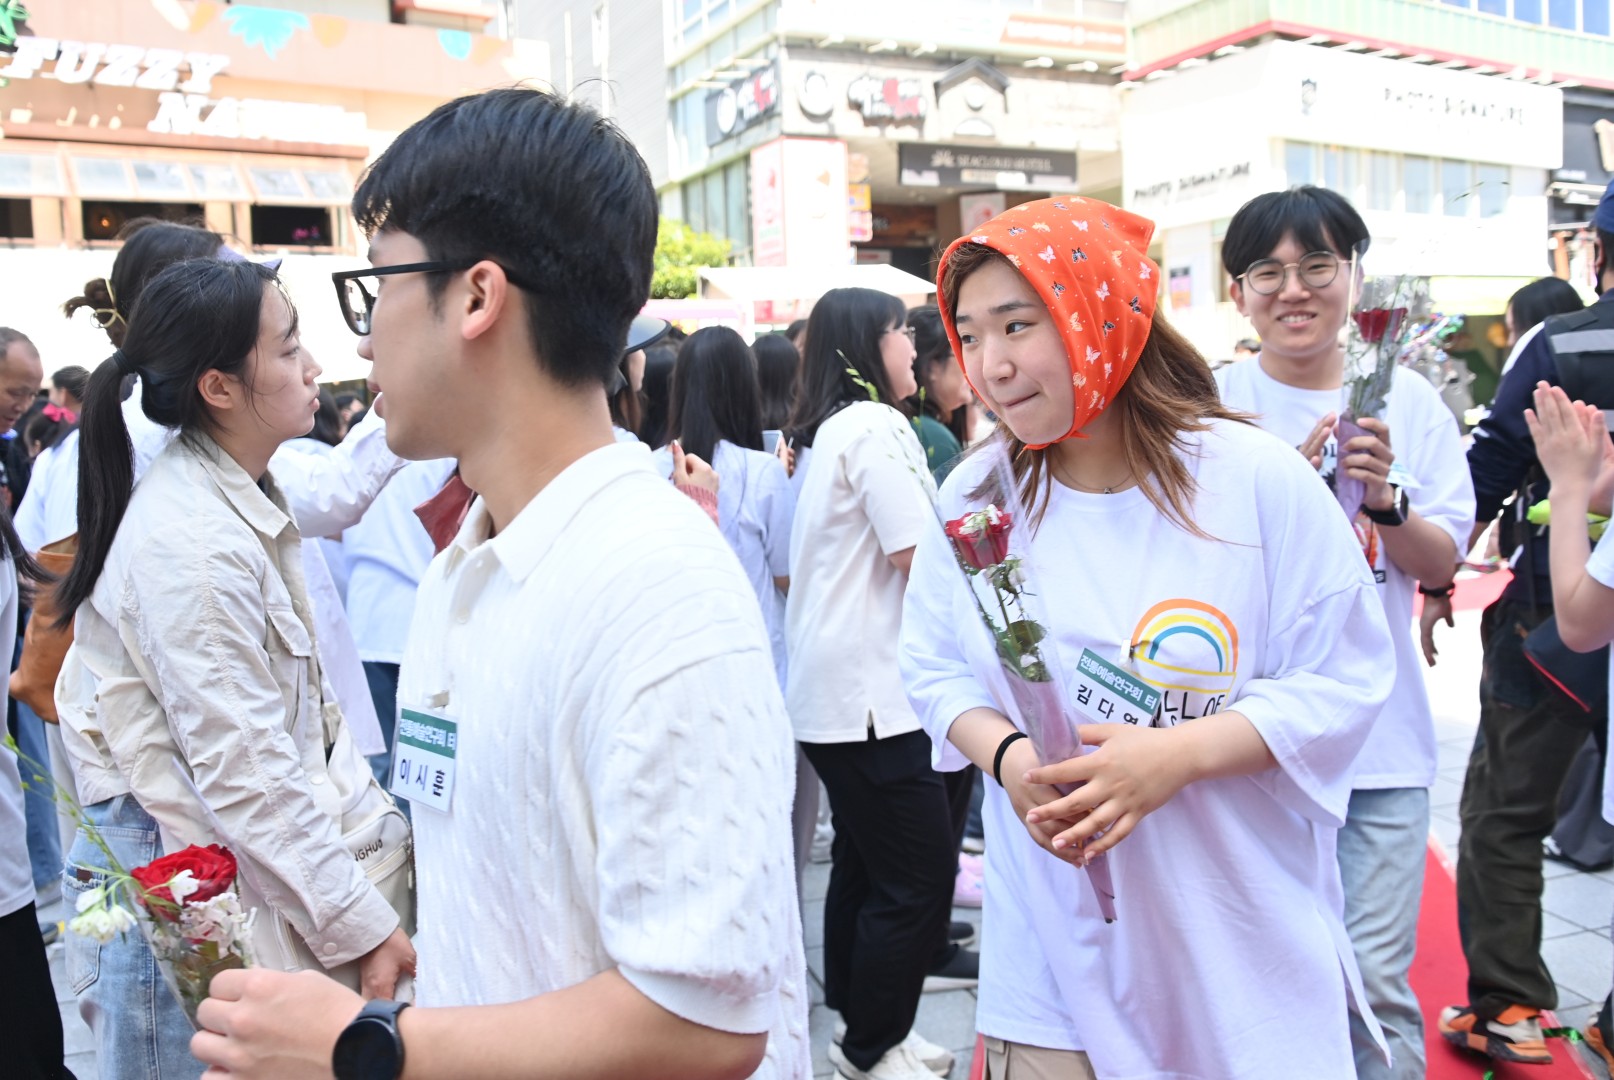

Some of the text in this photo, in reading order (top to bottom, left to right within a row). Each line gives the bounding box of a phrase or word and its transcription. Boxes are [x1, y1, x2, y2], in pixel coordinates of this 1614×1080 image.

[1, 36, 230, 93] FUZZY
[1080, 654, 1158, 710] 전통예술연구회 터
